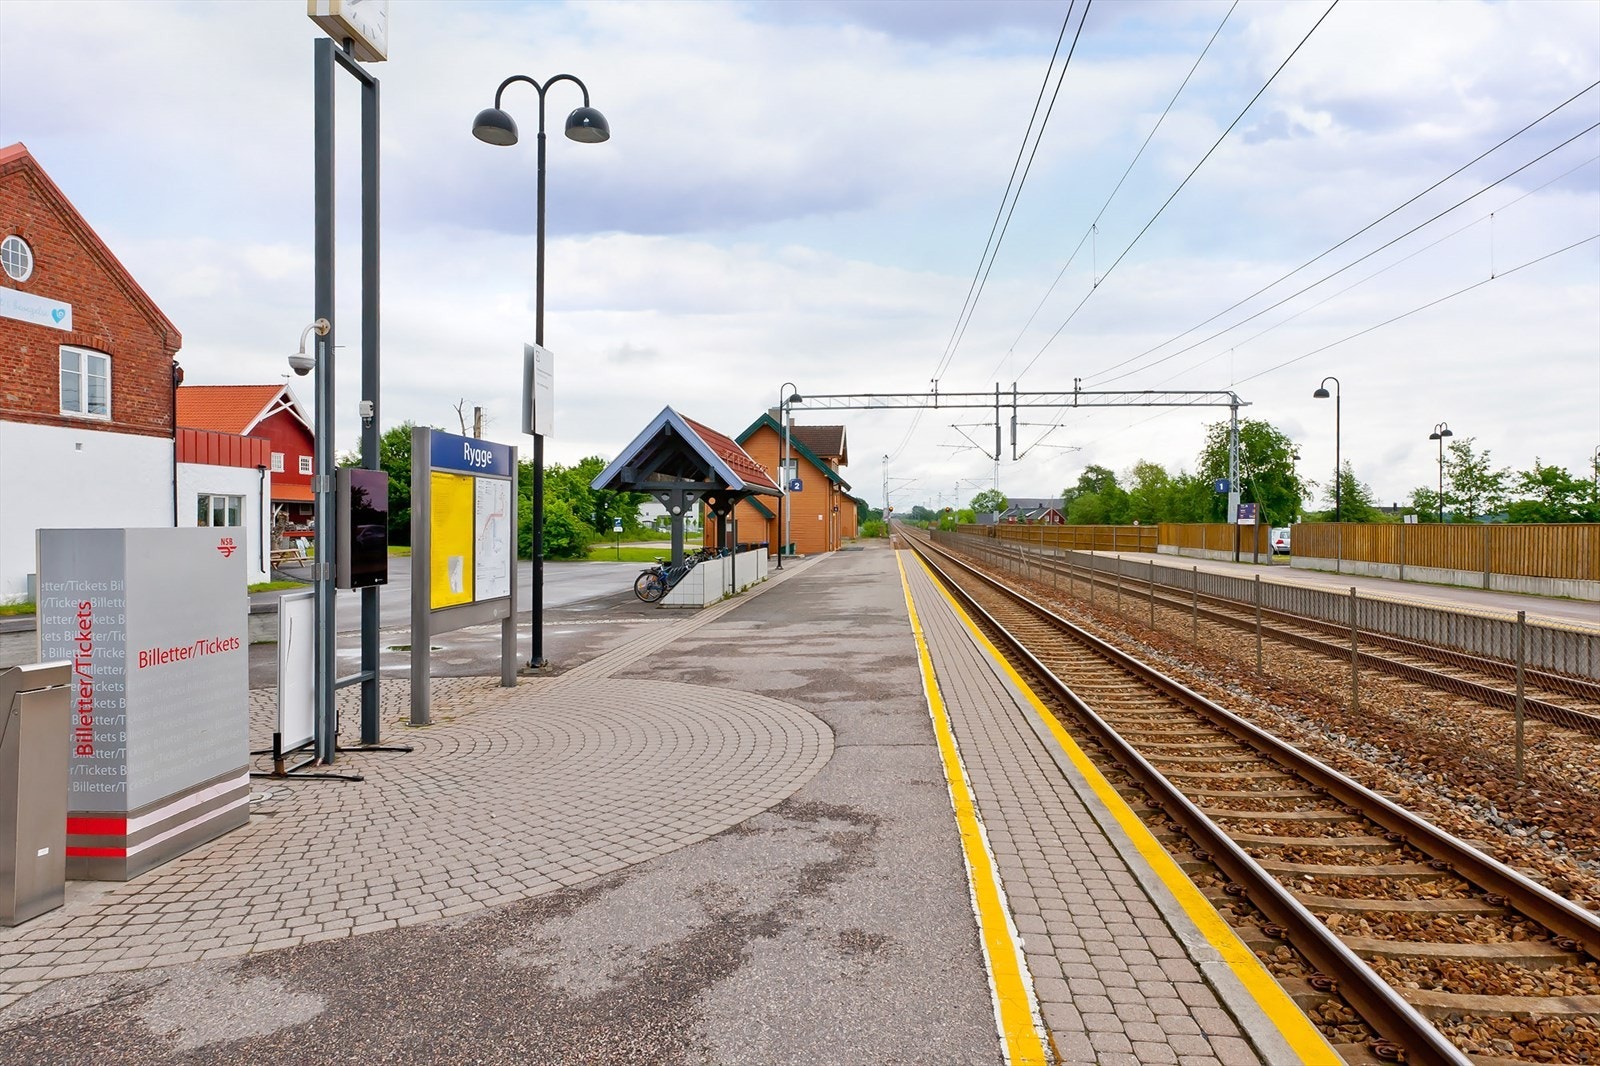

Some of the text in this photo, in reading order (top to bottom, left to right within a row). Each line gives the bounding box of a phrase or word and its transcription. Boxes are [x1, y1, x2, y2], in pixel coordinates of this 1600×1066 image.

[464, 442, 493, 468] Rygge
[794, 482, 800, 490] 2
[220, 537, 233, 545] NSB
[139, 637, 240, 669] Billetter/Tickets
[75, 601, 93, 755] Billetter/Tickets
